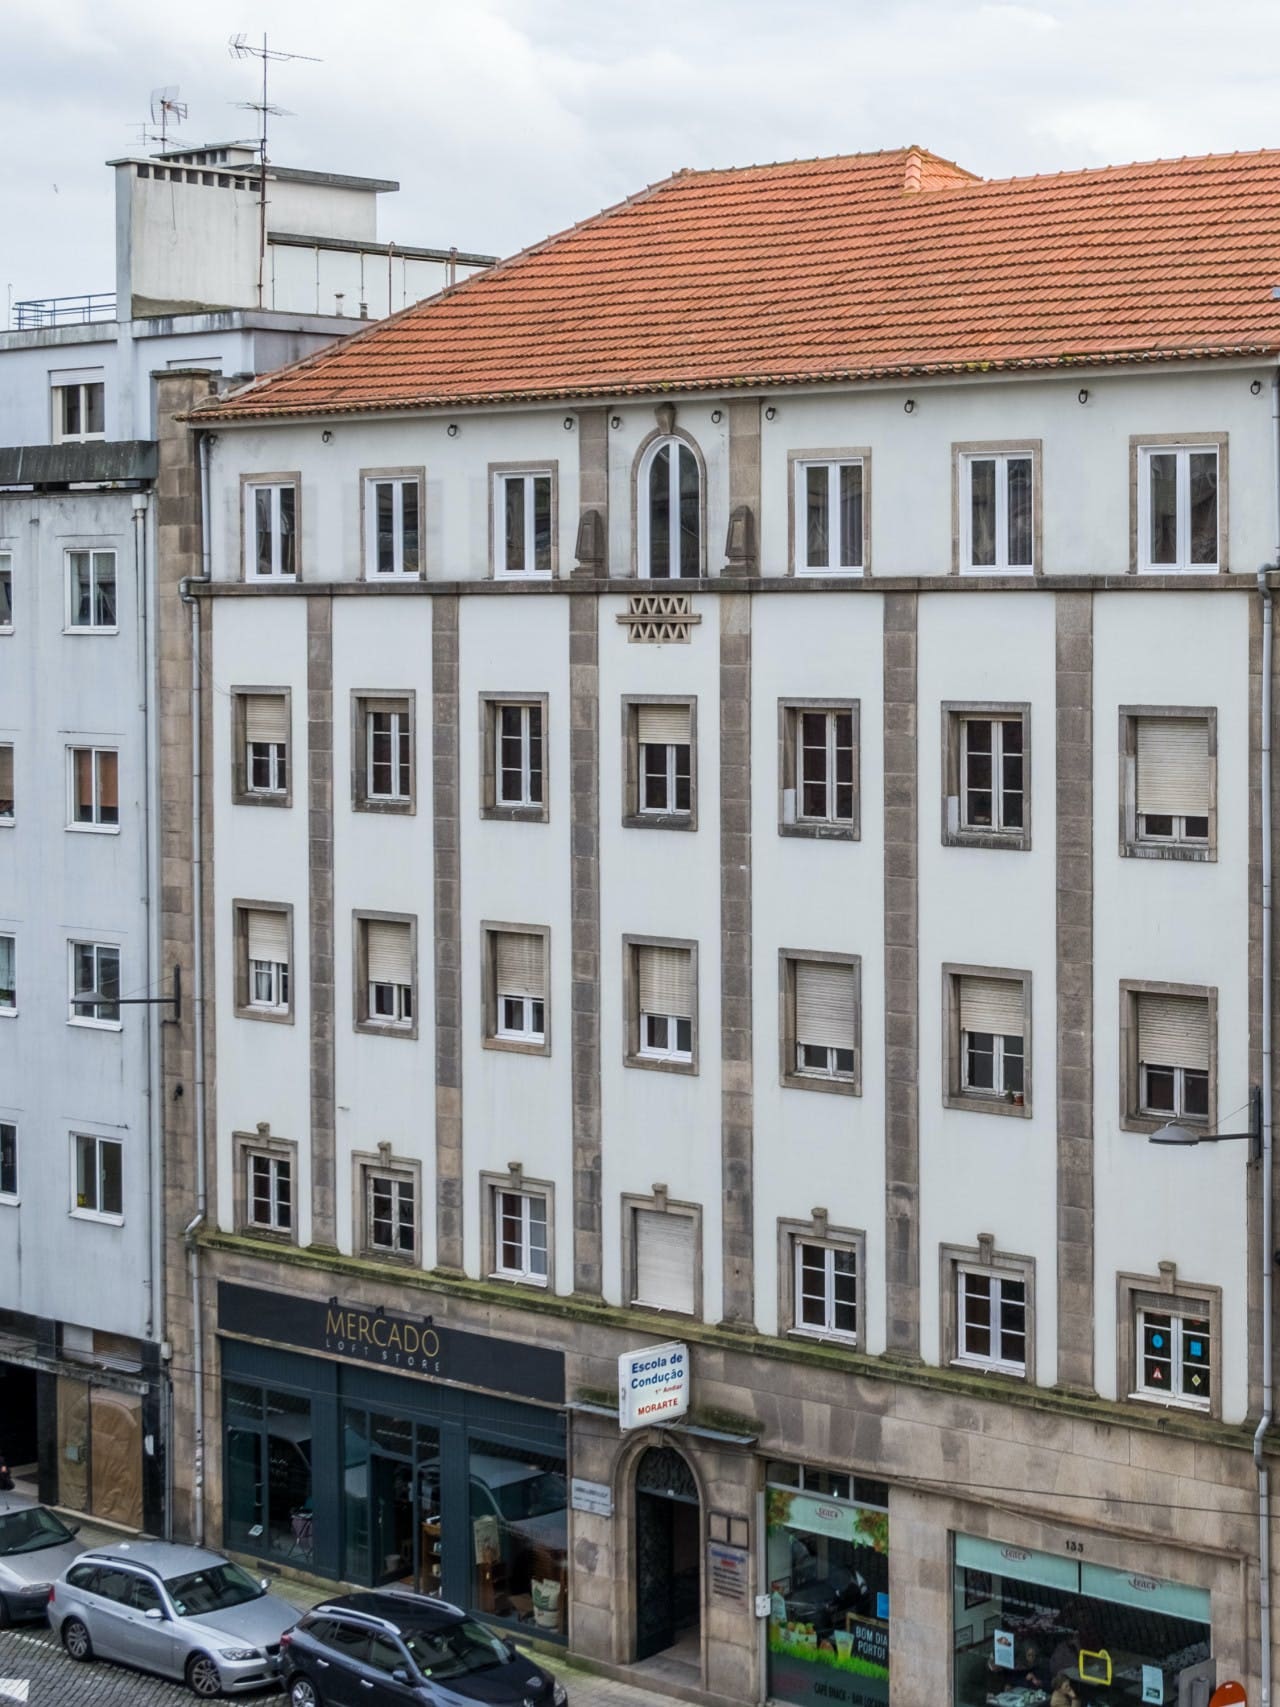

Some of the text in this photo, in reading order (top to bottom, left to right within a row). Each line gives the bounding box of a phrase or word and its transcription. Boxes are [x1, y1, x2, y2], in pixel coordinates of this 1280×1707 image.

[326, 1309, 440, 1358] MERCADO
[325, 1338, 440, 1373] LOFT STORE
[631, 1353, 683, 1374] Escola de
[631, 1368, 684, 1390] Condução
[637, 1398, 679, 1416] MORARTE
[855, 1626, 888, 1646] BOM DIA
